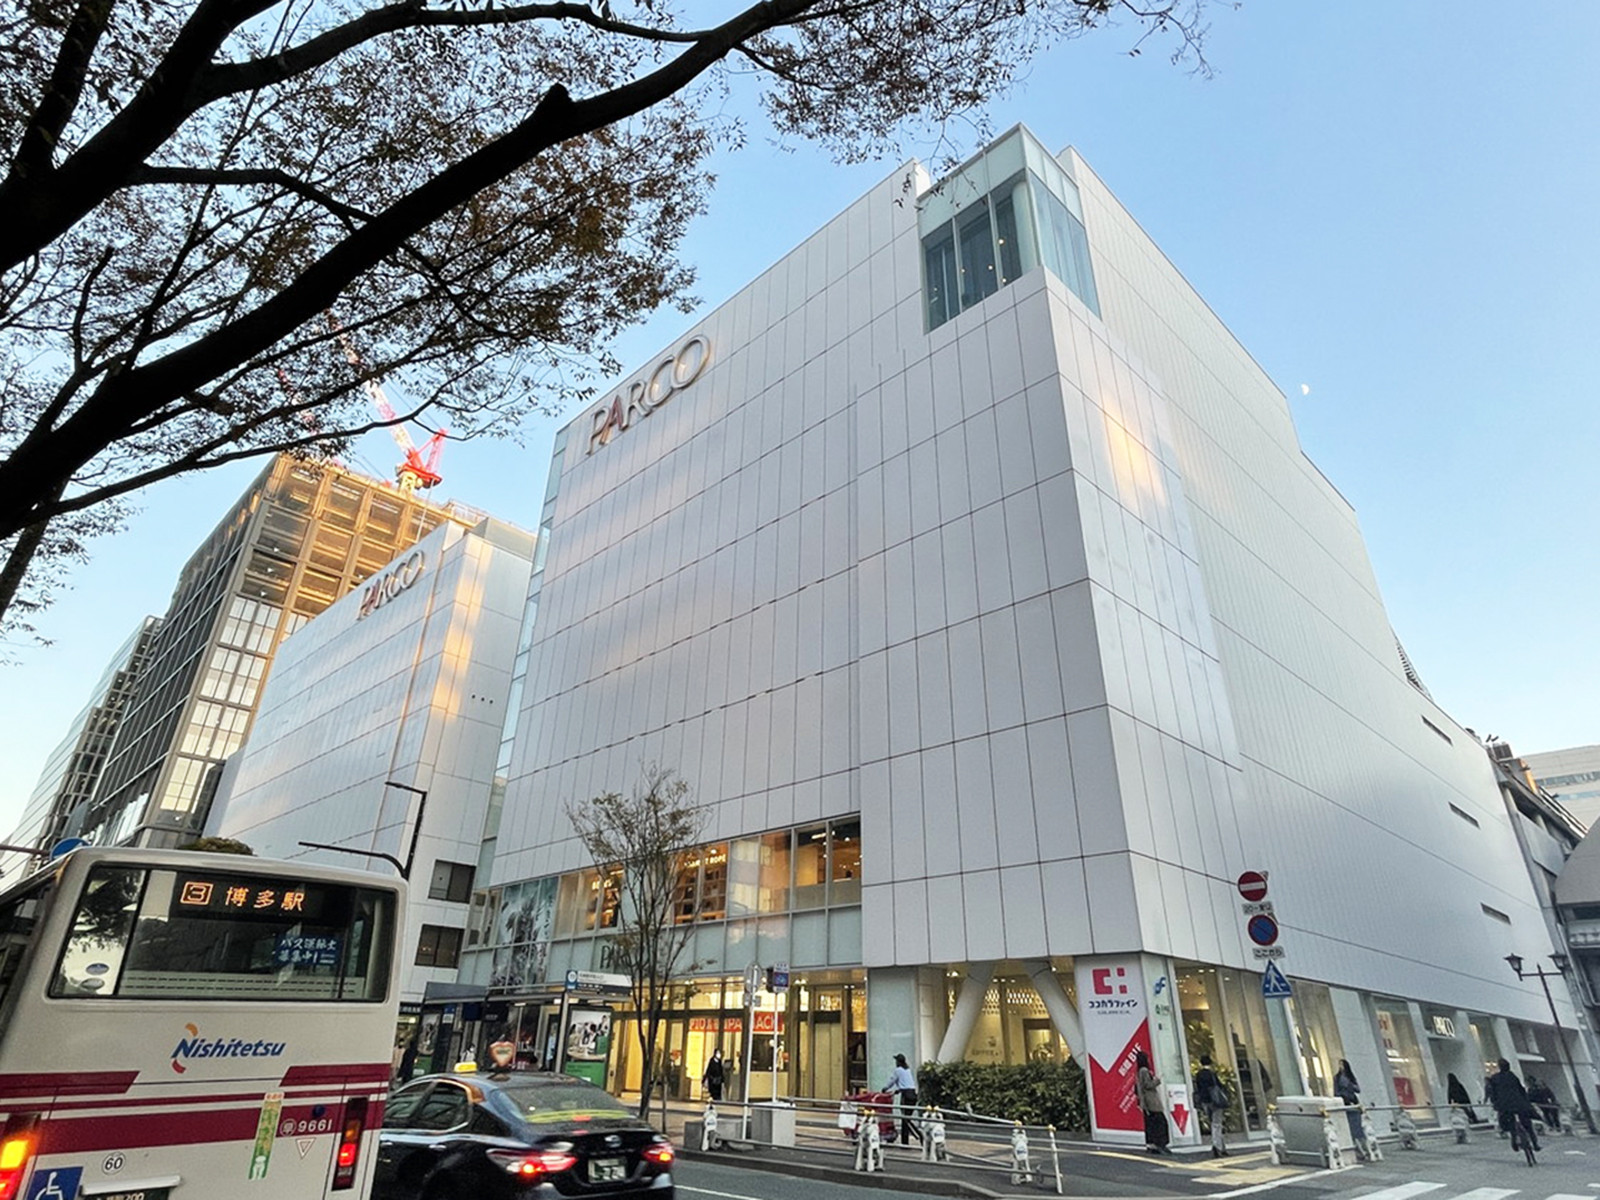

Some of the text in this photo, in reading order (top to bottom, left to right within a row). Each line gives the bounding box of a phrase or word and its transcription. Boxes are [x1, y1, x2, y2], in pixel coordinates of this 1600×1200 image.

[585, 334, 711, 457] PARCO
[356, 549, 425, 621] PARCO
[225, 886, 305, 912] 博多駅
[1088, 999, 1138, 1009] ココカラファイン
[171, 1038, 286, 1058] Nishitetsu
[298, 1119, 333, 1133] 9661
[104, 1156, 124, 1171] 60
